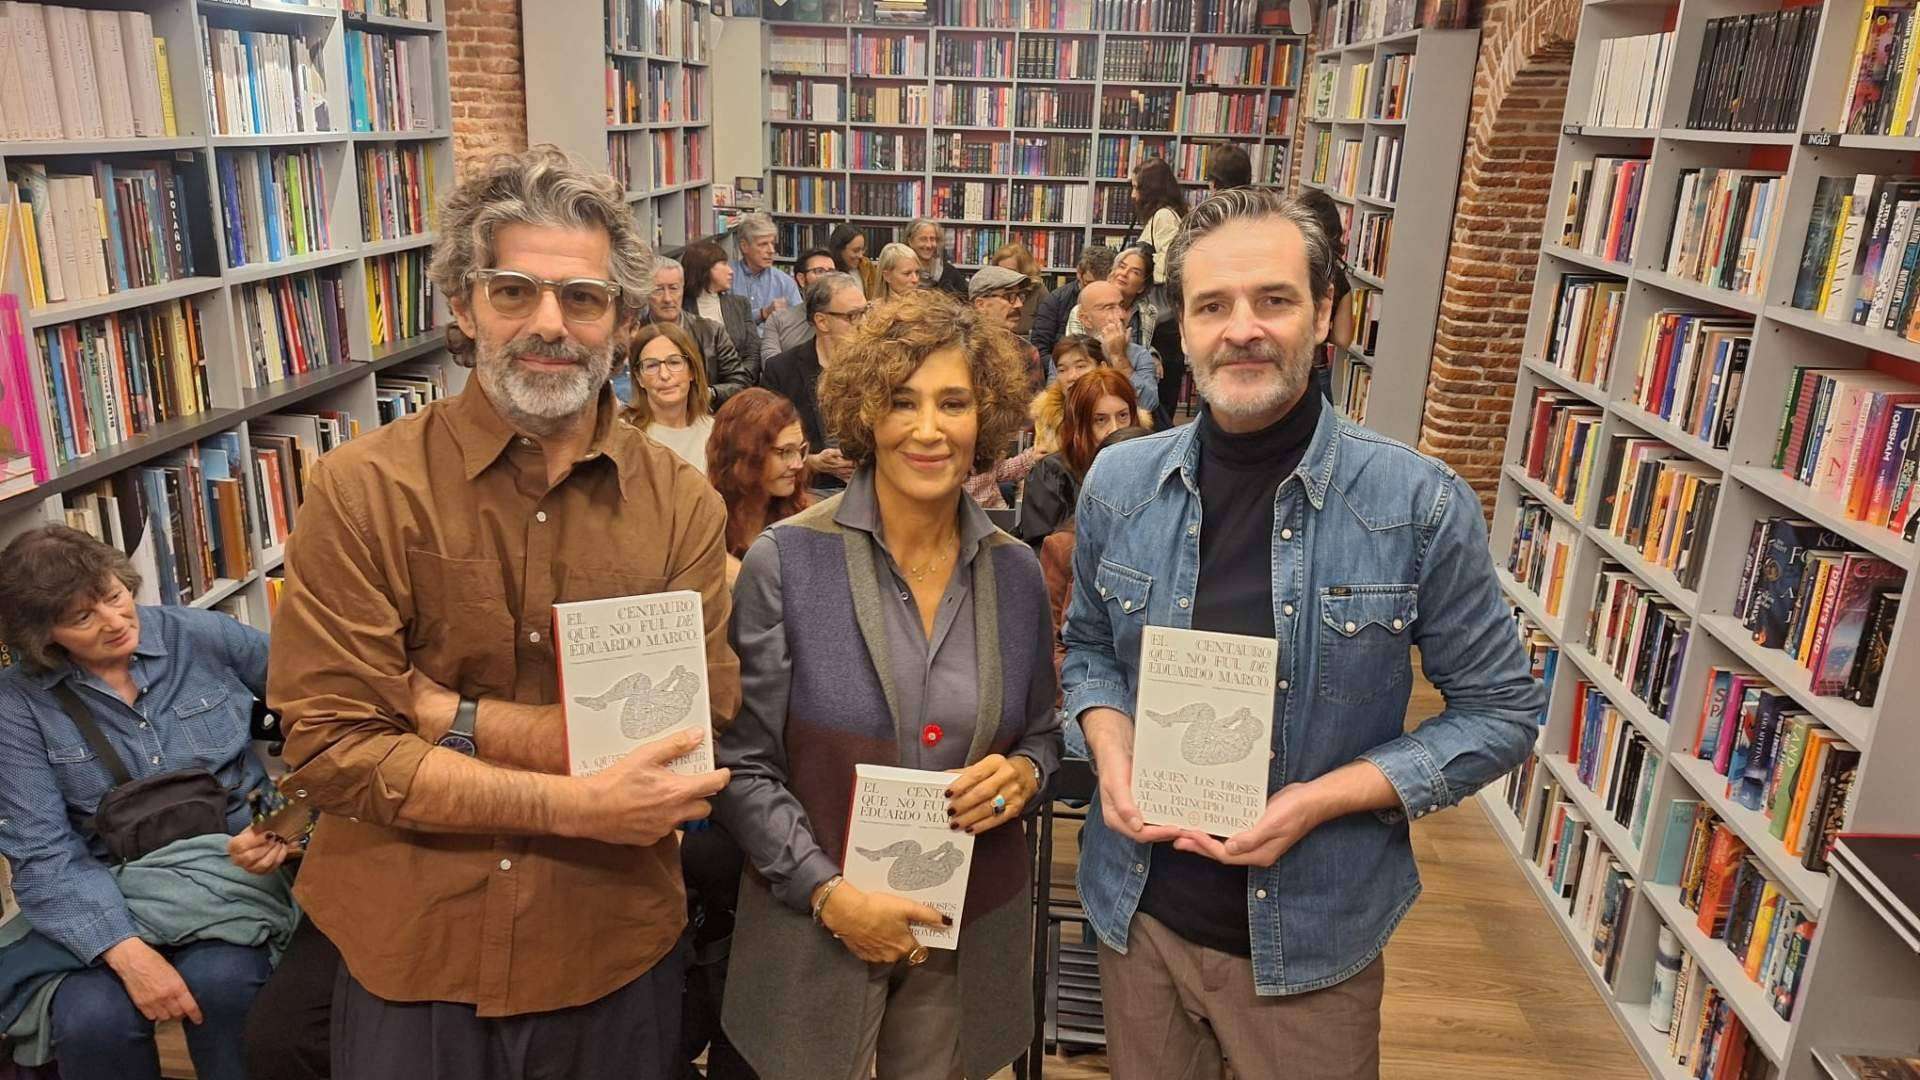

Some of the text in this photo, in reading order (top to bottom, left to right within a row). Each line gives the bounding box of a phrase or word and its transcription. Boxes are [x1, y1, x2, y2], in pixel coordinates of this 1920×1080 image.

[1808, 133, 1831, 146] INGLÉS
[1872, 192, 1888, 239] CAVANAGH
[1881, 203, 1892, 229] STEVE
[1820, 569, 1840, 625] DEATH'S
[568, 600, 694, 625] EL CENTAURO
[568, 626, 600, 643] QUE
[609, 623, 632, 636] NO
[676, 614, 694, 627] DE
[1813, 627, 1825, 655] END
[569, 637, 641, 656] EDUARDO
[1151, 634, 1272, 658] EL CENTAURO
[1147, 662, 1213, 681] EDUARDO
[1149, 648, 1176, 662] QUE
[1185, 652, 1207, 665] NO
[1249, 661, 1270, 674] DE
[1787, 723, 1803, 768] LAND
[864, 782, 943, 799] EL CENT
[1139, 769, 1260, 795] A QUIEN LOS DIOSES
[1139, 778, 1258, 808] DESEAN DESTRUIR
[860, 806, 921, 821] EDUARDO
[861, 794, 889, 807] QUE
[896, 797, 916, 809] NO
[1138, 790, 1258, 819] AL PRINCIPIO LO
